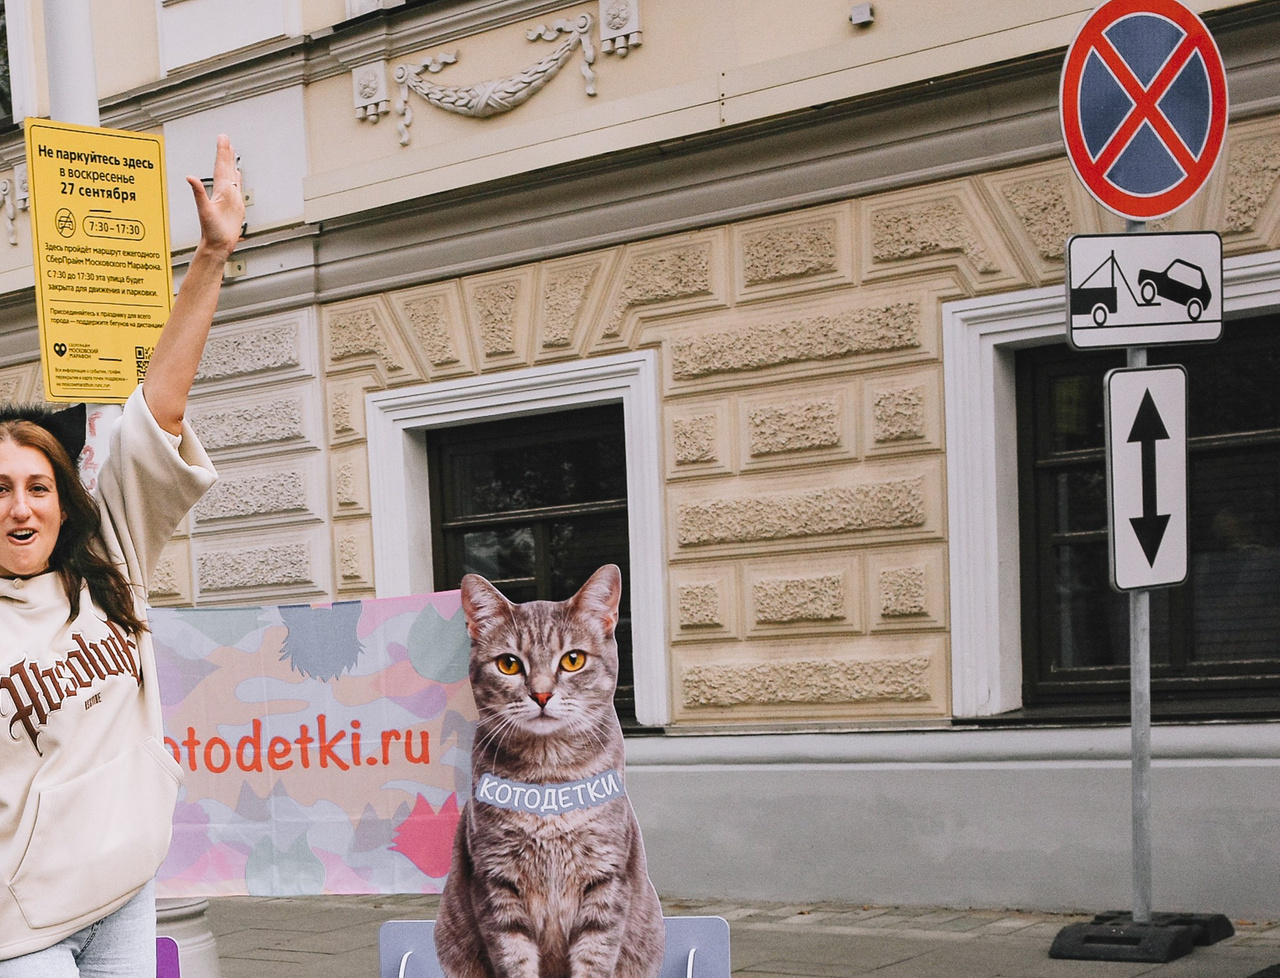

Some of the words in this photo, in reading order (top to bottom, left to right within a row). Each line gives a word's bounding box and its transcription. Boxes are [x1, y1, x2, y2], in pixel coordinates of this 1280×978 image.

[38, 144, 54, 158] Не
[56, 149, 121, 166] паркуйтесь
[122, 157, 154, 170] здесь
[59, 167, 66, 177] в
[68, 168, 135, 185] воскресенье
[60, 181, 75, 195] 27
[78, 186, 137, 203] сентября
[45, 242, 64, 252] Здесь
[93, 247, 121, 258] маршрут
[122, 249, 160, 259] ежегодного
[45, 254, 84, 266] СберПрайм
[85, 258, 127, 268] Московского
[127, 261, 162, 271] Марафона.
[46, 269, 52, 278] С
[53, 271, 67, 279] 7:30
[77, 272, 95, 281] 17:30
[107, 275, 125, 284] улица
[126, 275, 144, 285] будет
[48, 283, 74, 292] закрыта
[75, 285, 88, 293] для
[88, 286, 121, 295] движения
[126, 289, 159, 298] парковки.
[479, 773, 620, 813] КОТОДЕТКИ
